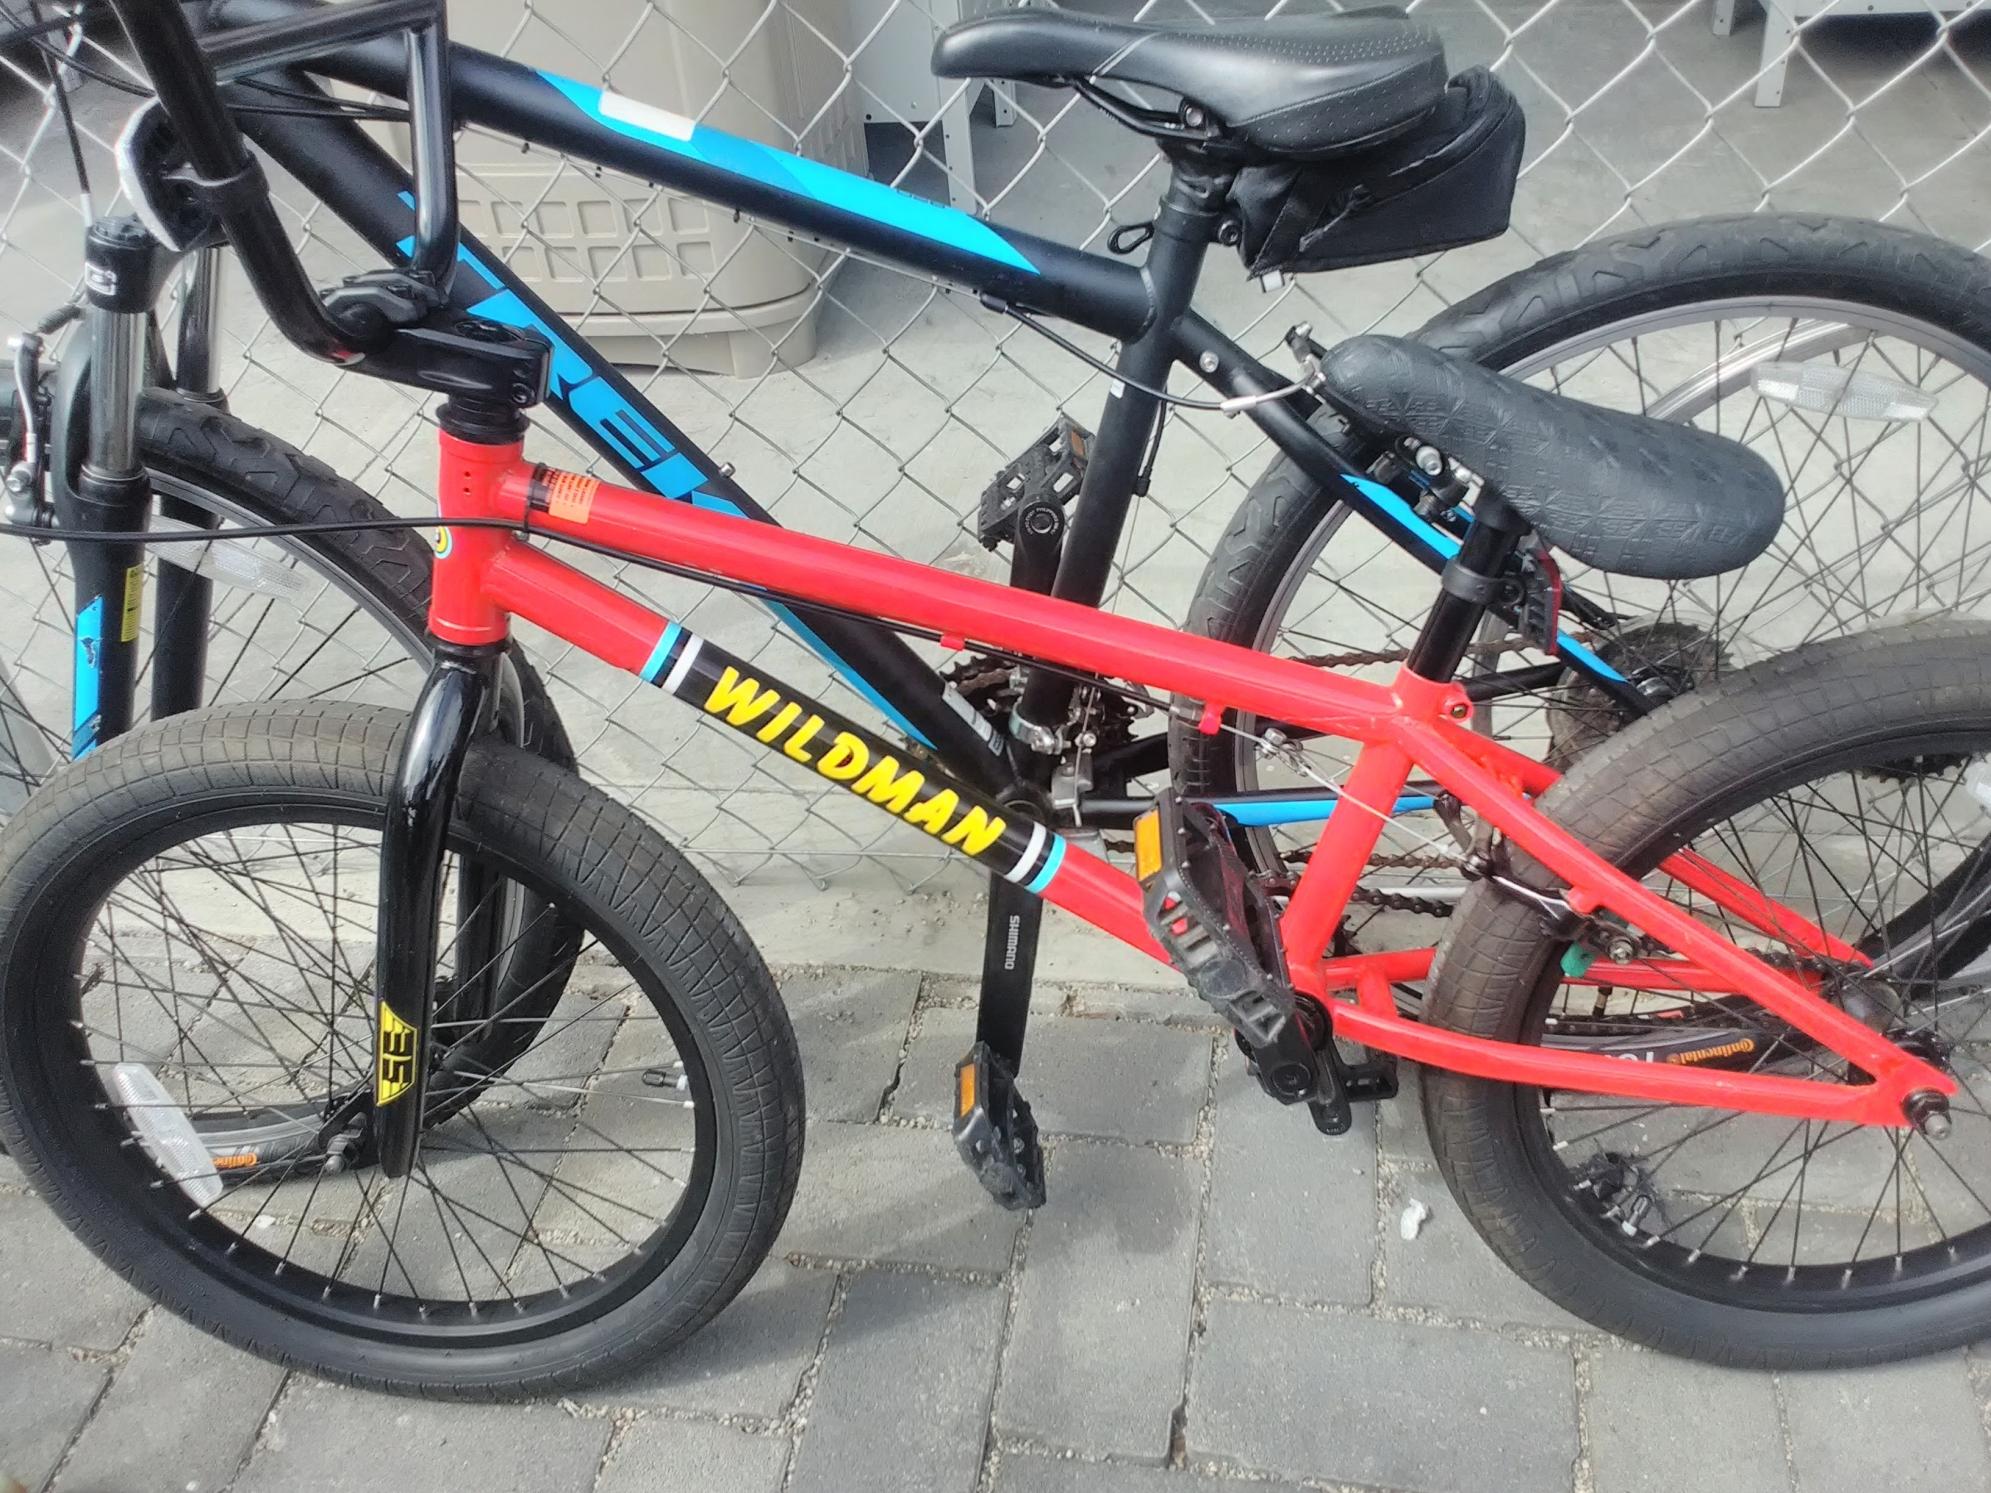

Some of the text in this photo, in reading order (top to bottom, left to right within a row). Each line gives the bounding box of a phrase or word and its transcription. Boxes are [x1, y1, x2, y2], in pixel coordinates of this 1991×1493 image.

[703, 666, 1006, 856] WILDMAN
[1004, 915, 1021, 971] SHIMANO
[1679, 1038, 1756, 1065] Continental
